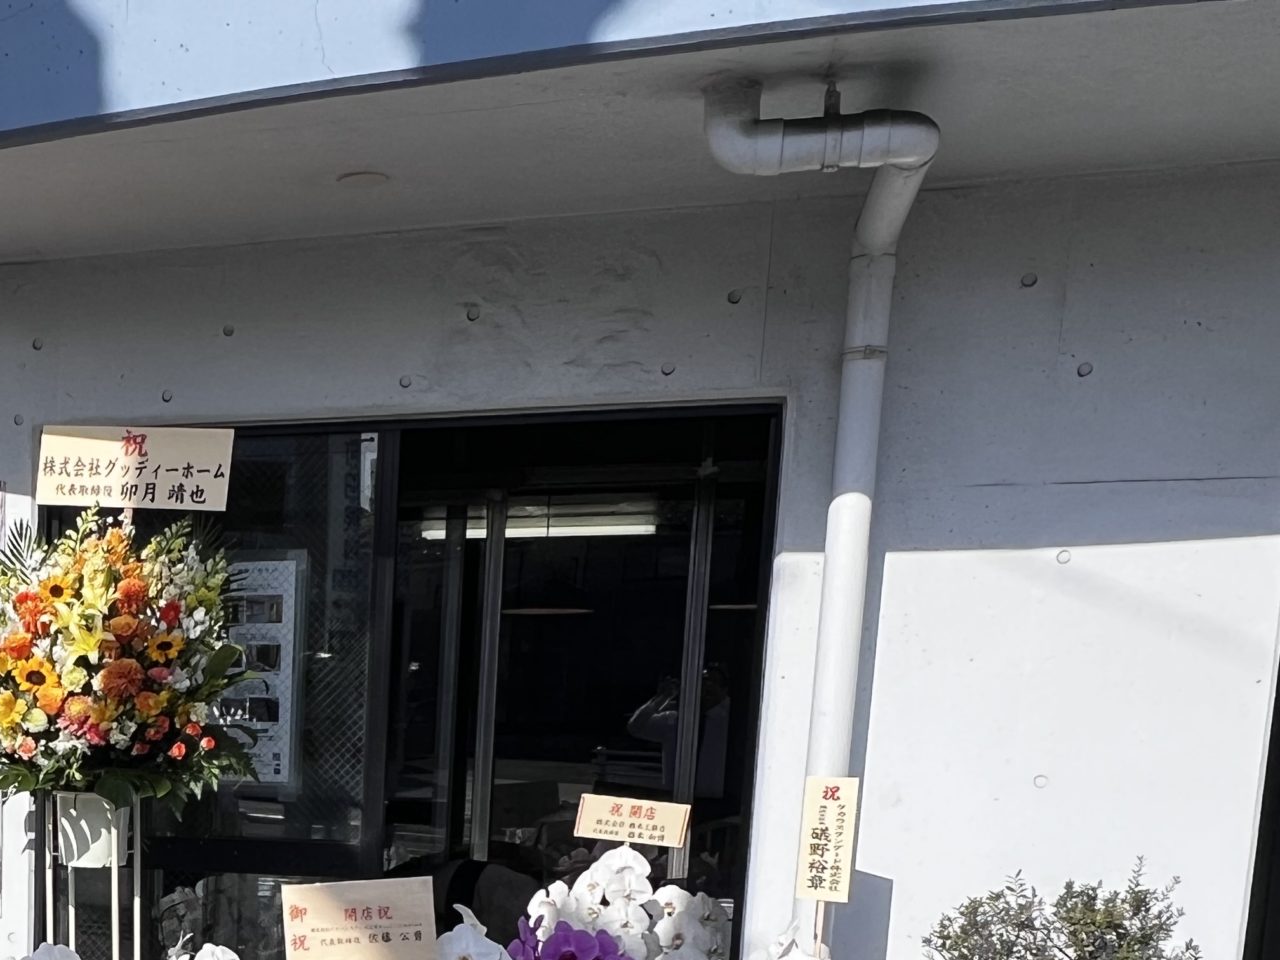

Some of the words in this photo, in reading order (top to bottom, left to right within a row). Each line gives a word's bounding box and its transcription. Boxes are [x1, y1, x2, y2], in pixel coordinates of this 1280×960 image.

[121, 429, 148, 457] 祝
[43, 456, 226, 480] 株式会社グッディーホーム
[55, 484, 113, 498] 代表取締役
[120, 482, 156, 504] 卯月
[822, 785, 841, 801] 祝
